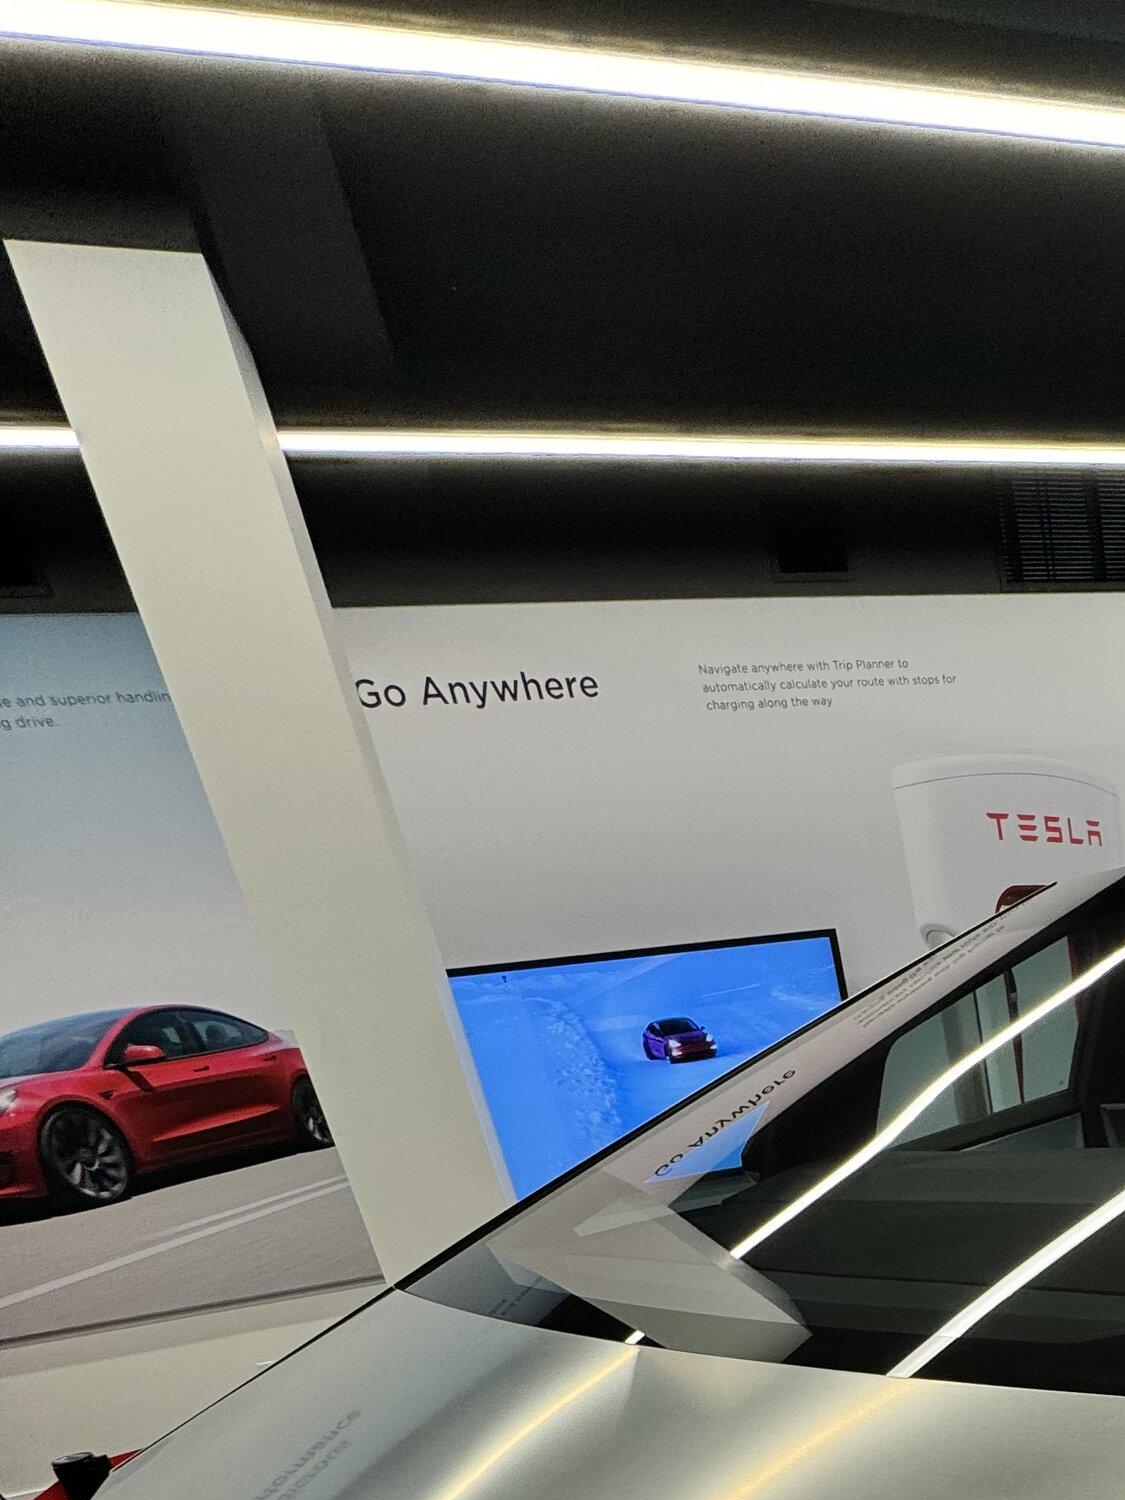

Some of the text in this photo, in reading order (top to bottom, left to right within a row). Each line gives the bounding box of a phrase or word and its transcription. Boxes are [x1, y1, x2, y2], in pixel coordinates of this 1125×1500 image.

[698, 659, 909, 677] Navigate anywhere with Trip Planner to
[354, 671, 599, 710] Go Anywhere
[702, 674, 957, 693] automatically calculate your route with stops for
[16, 694, 46, 708] and
[50, 693, 112, 707] superior
[116, 690, 172, 704] handlin
[706, 696, 832, 712] charging along the way
[985, 812, 1103, 847] TESLA
